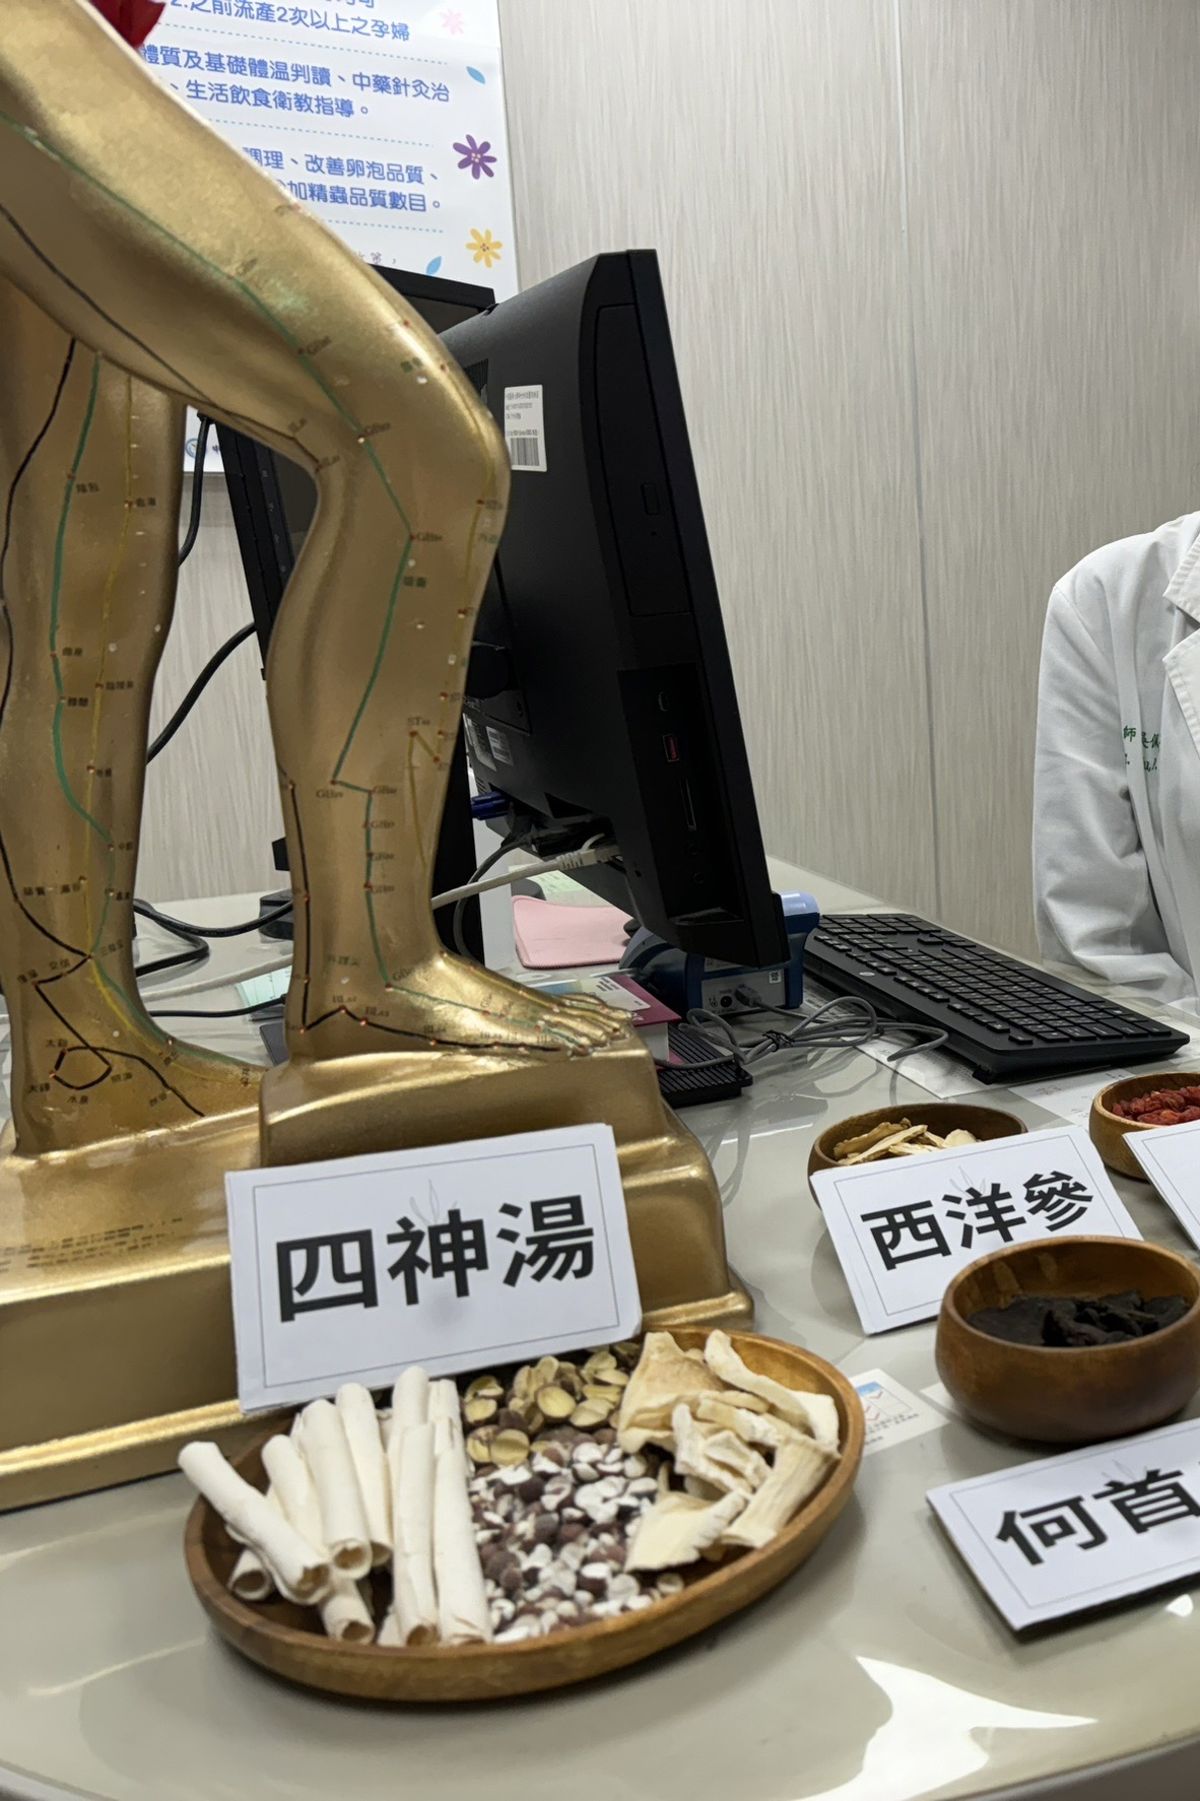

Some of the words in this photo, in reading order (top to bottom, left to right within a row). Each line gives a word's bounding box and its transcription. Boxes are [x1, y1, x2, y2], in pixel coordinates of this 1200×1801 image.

[277, 179, 441, 212] 加精蟲品質數目。
[276, 1194, 594, 1322] 四神湯
[860, 1170, 1094, 1271] 西洋參
